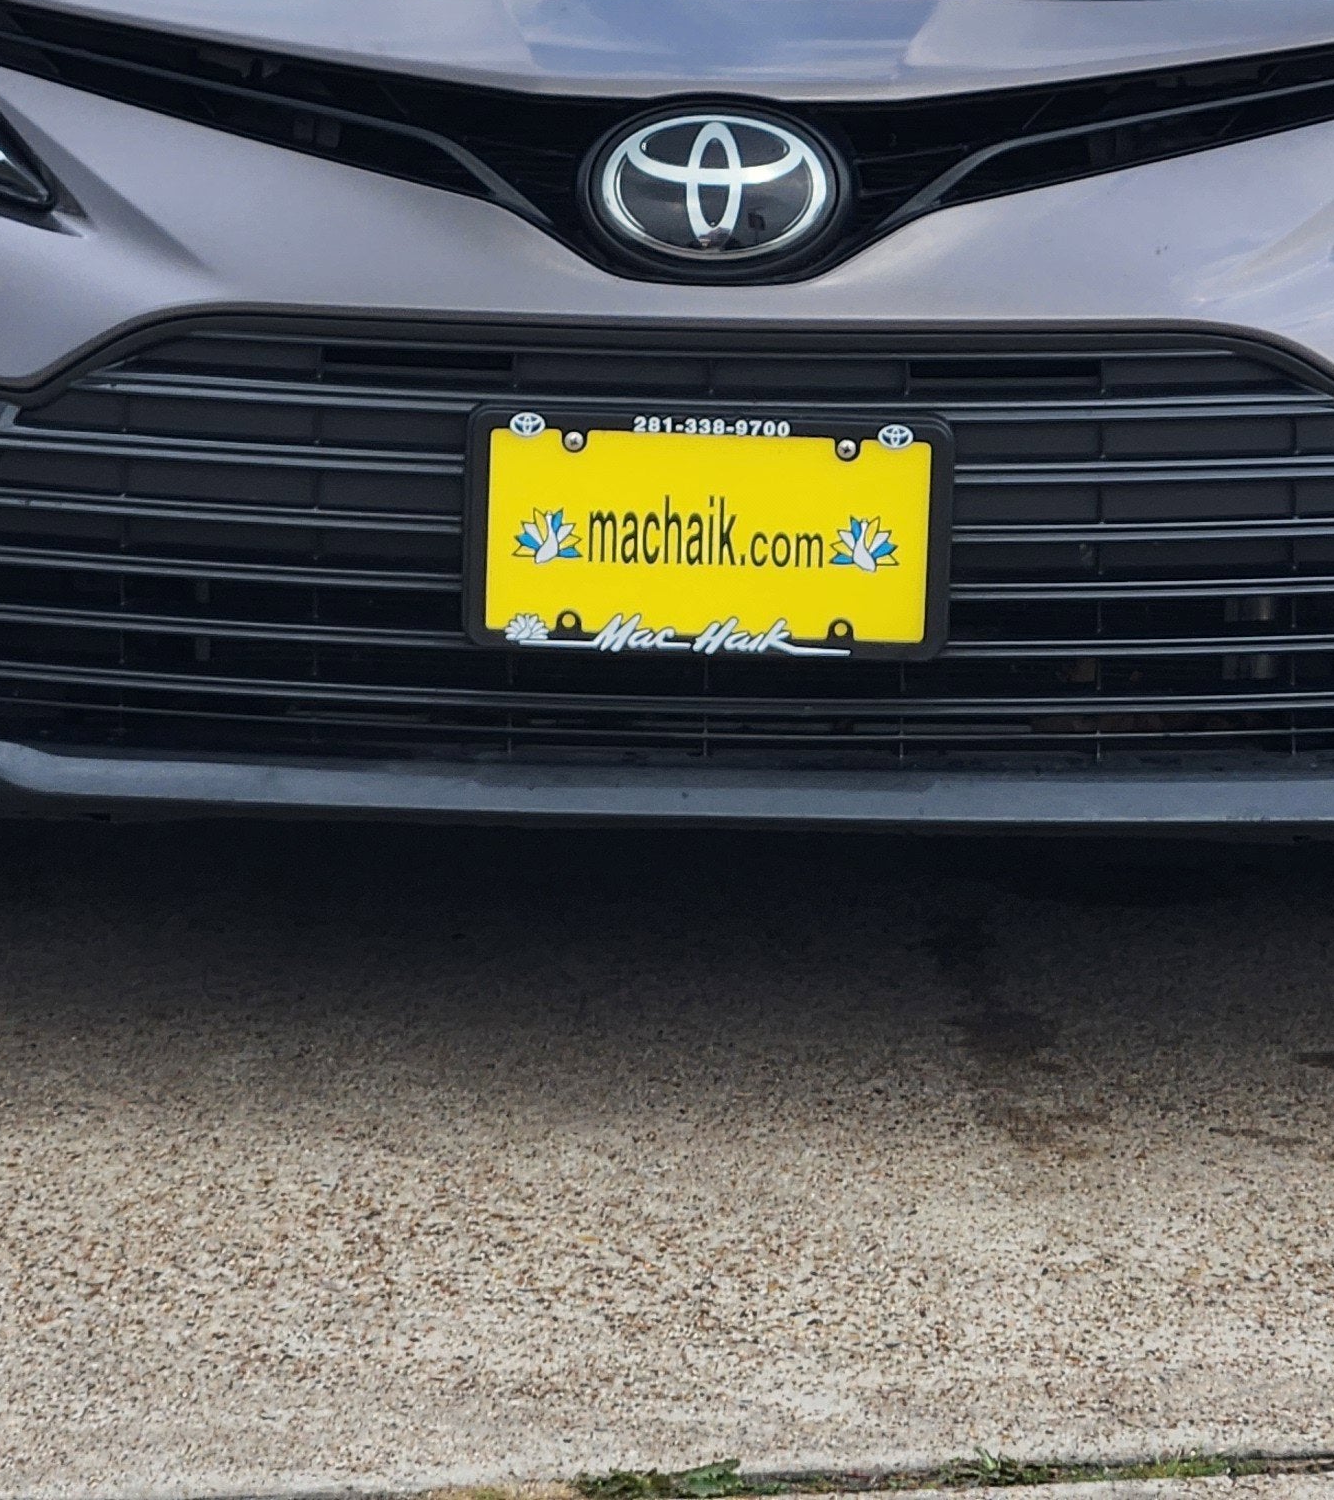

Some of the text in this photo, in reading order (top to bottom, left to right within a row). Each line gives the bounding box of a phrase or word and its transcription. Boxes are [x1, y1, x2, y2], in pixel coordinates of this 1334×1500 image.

[633, 415, 791, 437] 281-338-9700
[587, 494, 824, 569] machaik.com
[591, 612, 793, 656] Mac Haik
